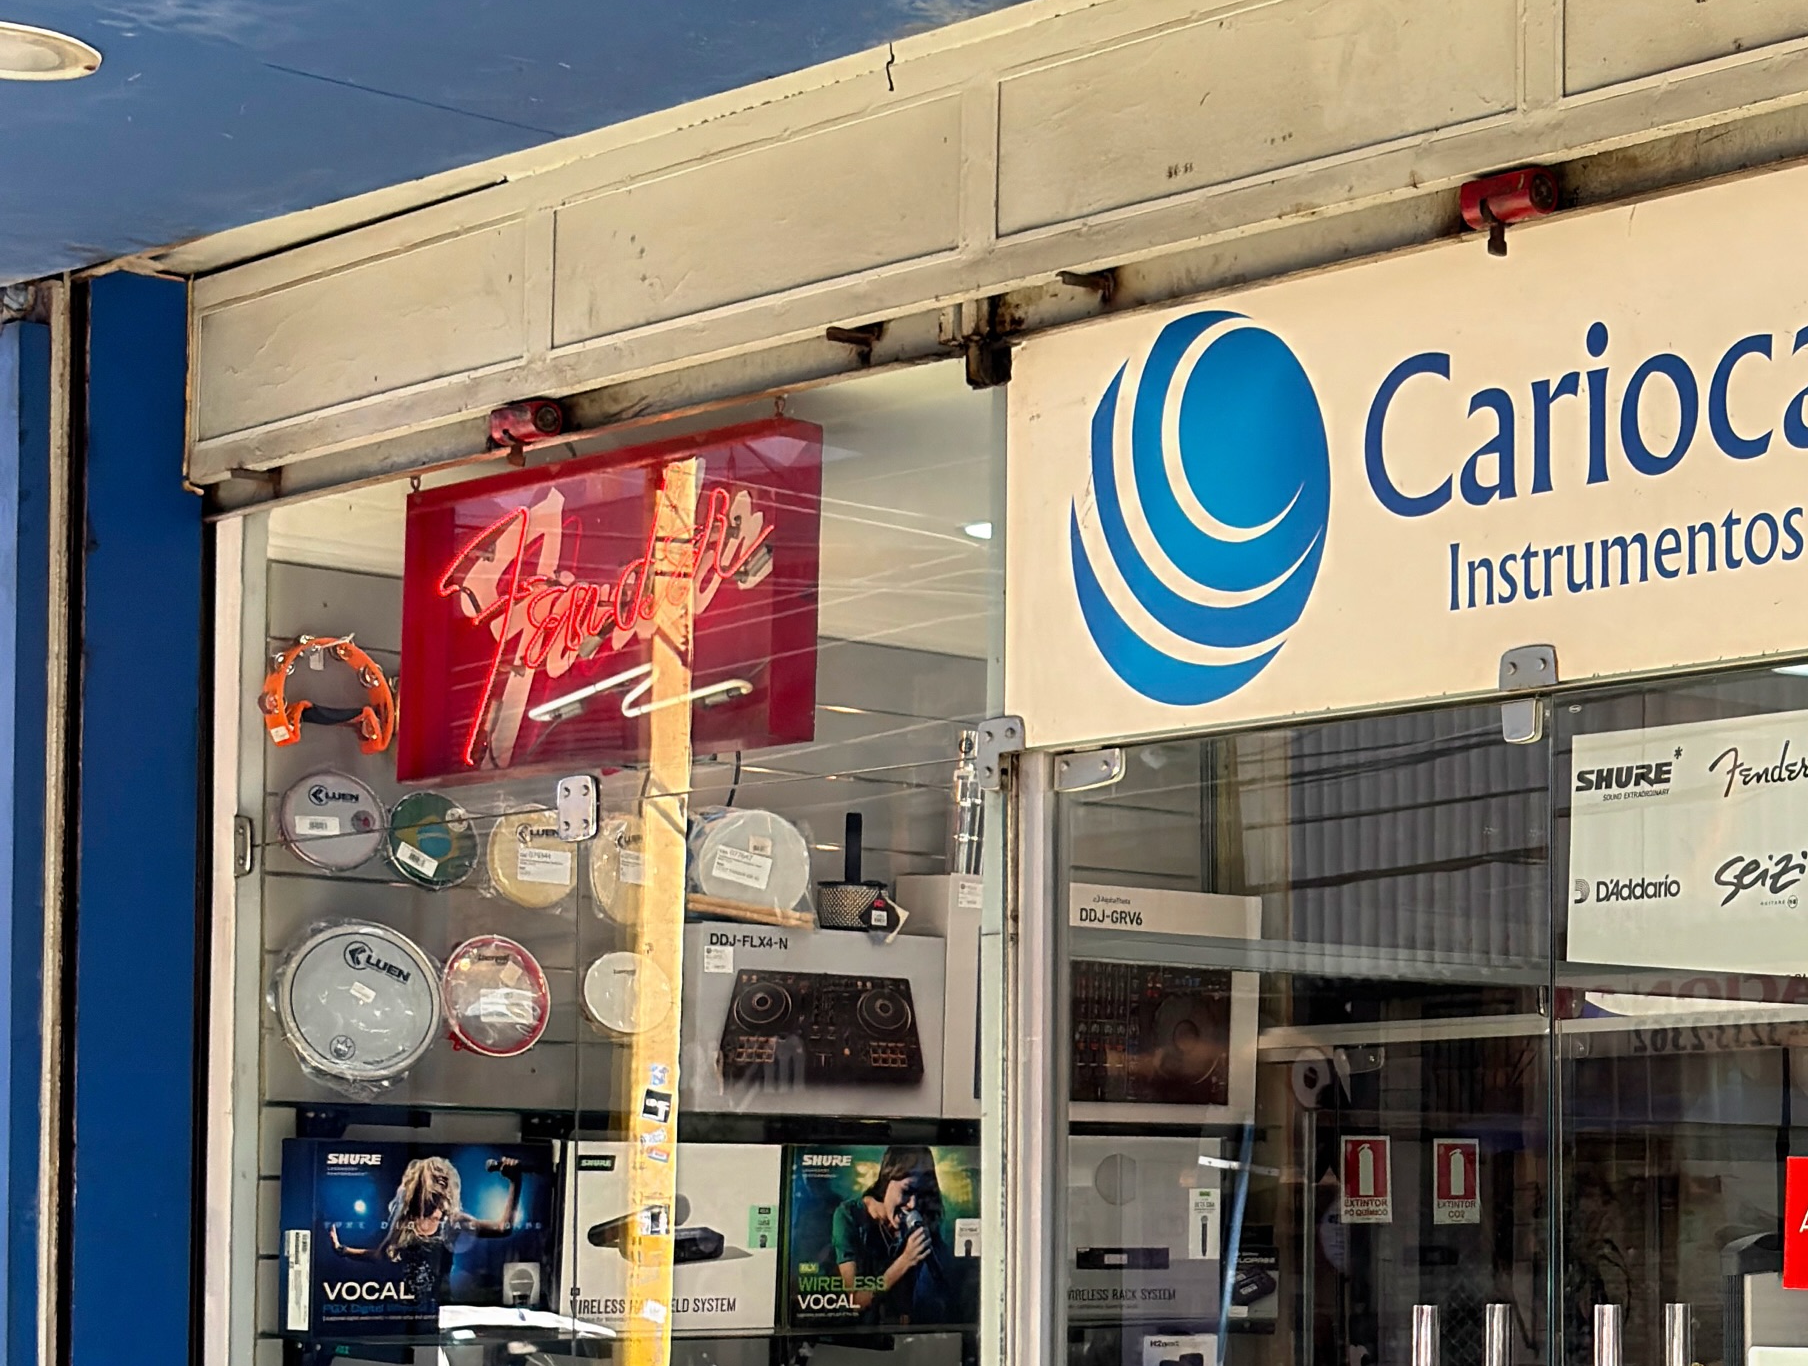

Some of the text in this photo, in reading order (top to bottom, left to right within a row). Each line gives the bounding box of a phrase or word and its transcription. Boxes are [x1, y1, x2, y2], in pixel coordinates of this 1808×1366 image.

[1449, 506, 1805, 612] Instrumentos
[438, 471, 776, 766] Fender
[1575, 761, 1673, 792] SHURE
[1714, 850, 1808, 907] Seizi
[1595, 876, 1681, 904] D'Addario
[1079, 907, 1143, 926] DDJ-GRV6
[709, 932, 788, 950] DDJ-FLX4-N
[366, 954, 412, 983] LUEN
[326, 1153, 382, 1166] SHURE
[802, 1154, 852, 1166] SHURE
[1344, 1198, 1388, 1208] EXTINTOR
[1437, 1200, 1476, 1209] EXTINTOR
[323, 1281, 416, 1301] VOCAL
[799, 1276, 888, 1292] WIRELESS
[692, 1297, 737, 1313] SYSTEM
[797, 1293, 861, 1310] VOCAL
